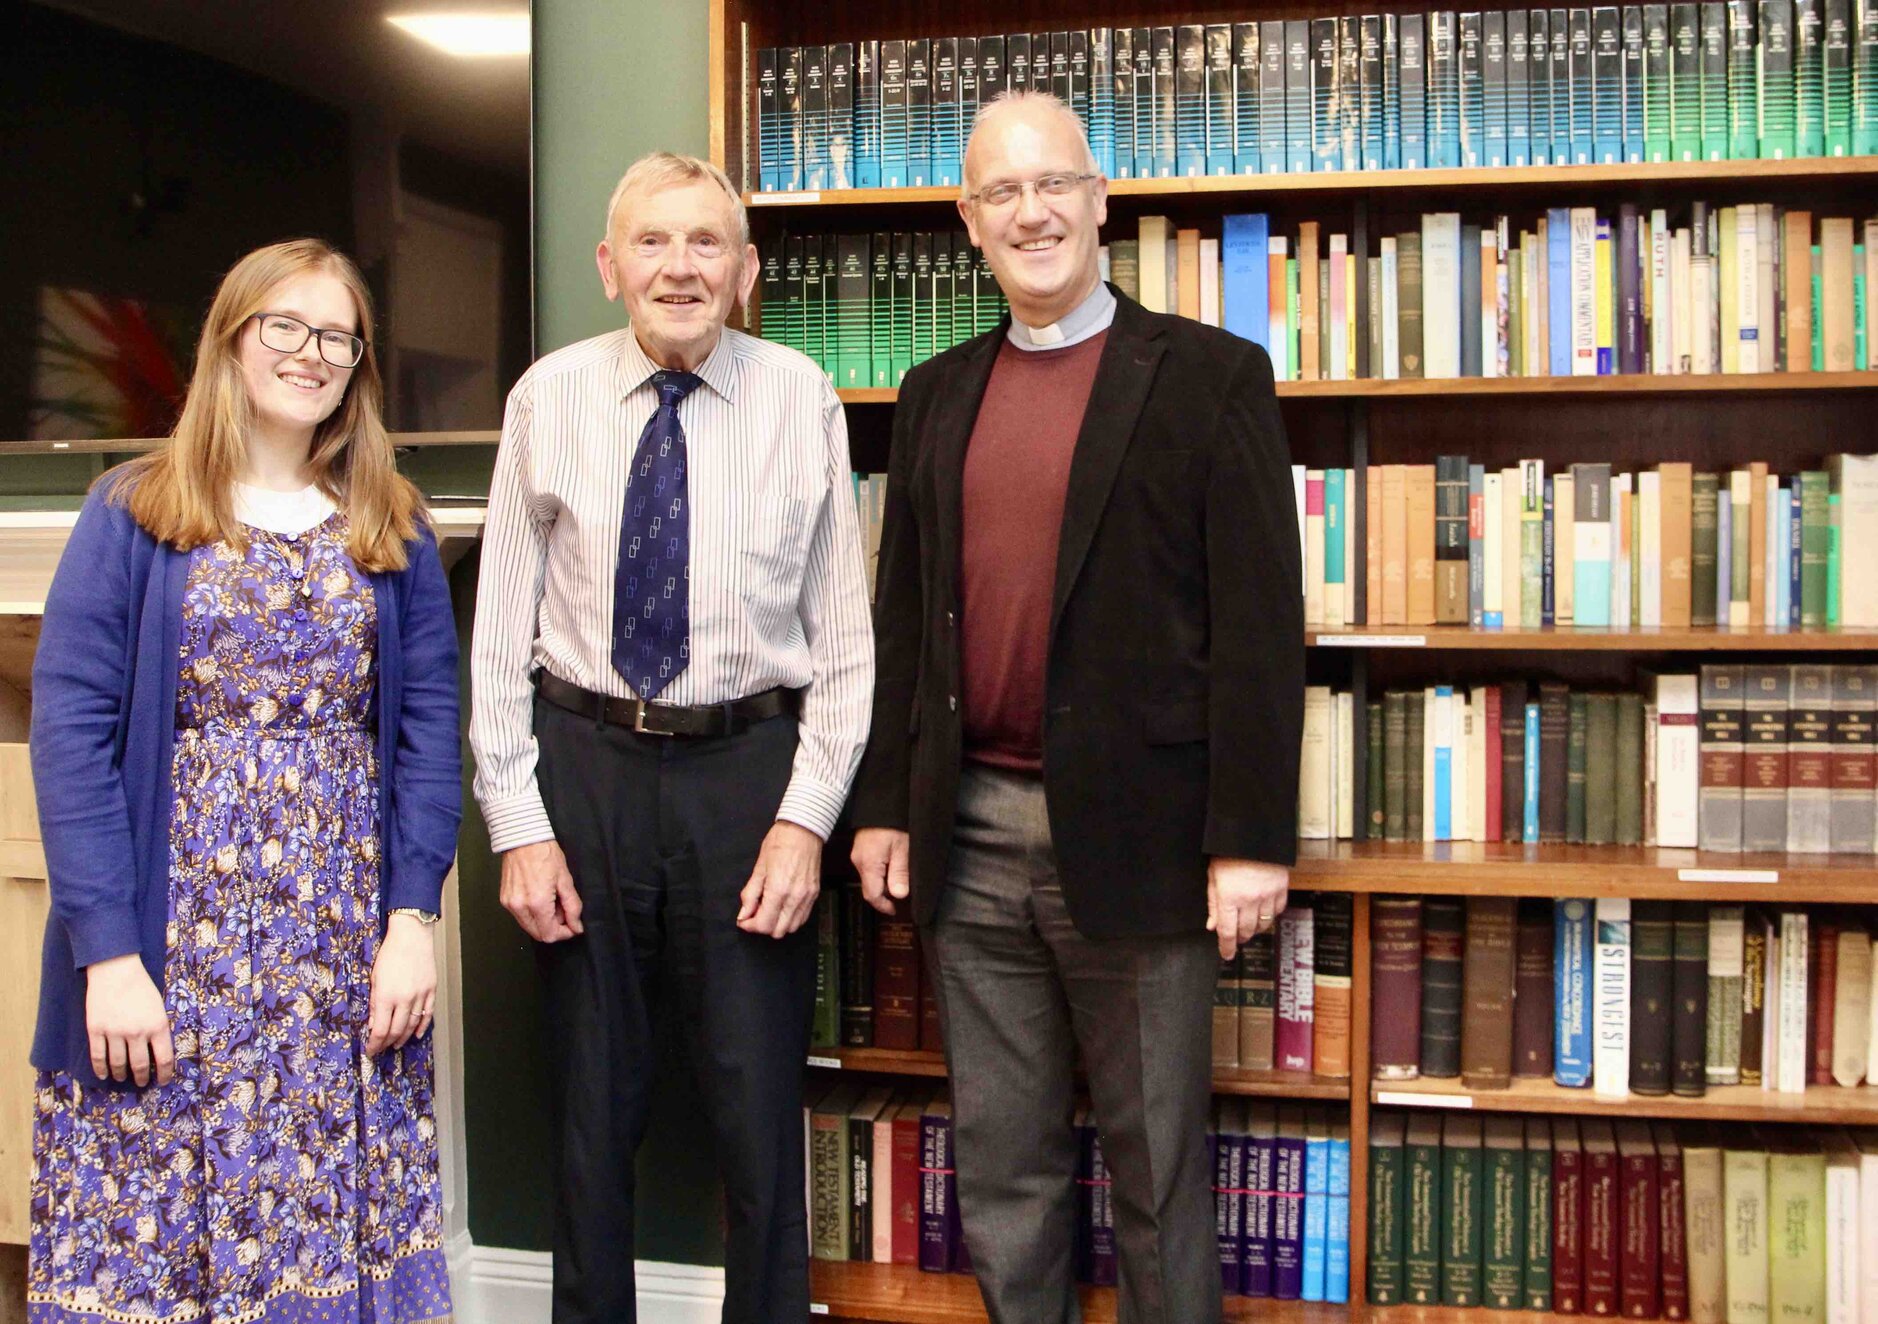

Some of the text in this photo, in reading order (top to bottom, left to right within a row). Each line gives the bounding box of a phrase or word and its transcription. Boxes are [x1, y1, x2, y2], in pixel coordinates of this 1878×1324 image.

[1576, 242, 1592, 292] APPLICATION
[1655, 232, 1665, 278] RUTH
[1279, 919, 1295, 1021] COMMENTARY
[1295, 919, 1314, 1023] NEW BIBLE
[1601, 948, 1625, 1052] STRONGEST
[814, 1130, 827, 1239] INTRODUCTION
[827, 1130, 840, 1239] NEW TESTAMENT
[924, 1125, 935, 1214] OF THE NEW TESTAMENT
[935, 1127, 945, 1216] THEOLOGICAL DICTIONARY
[1248, 1158, 1258, 1172] THE
[1278, 1159, 1289, 1173] THE
[1246, 1195, 1257, 1238] TESTAMENT
[1275, 1197, 1287, 1240] TESTAMENT
